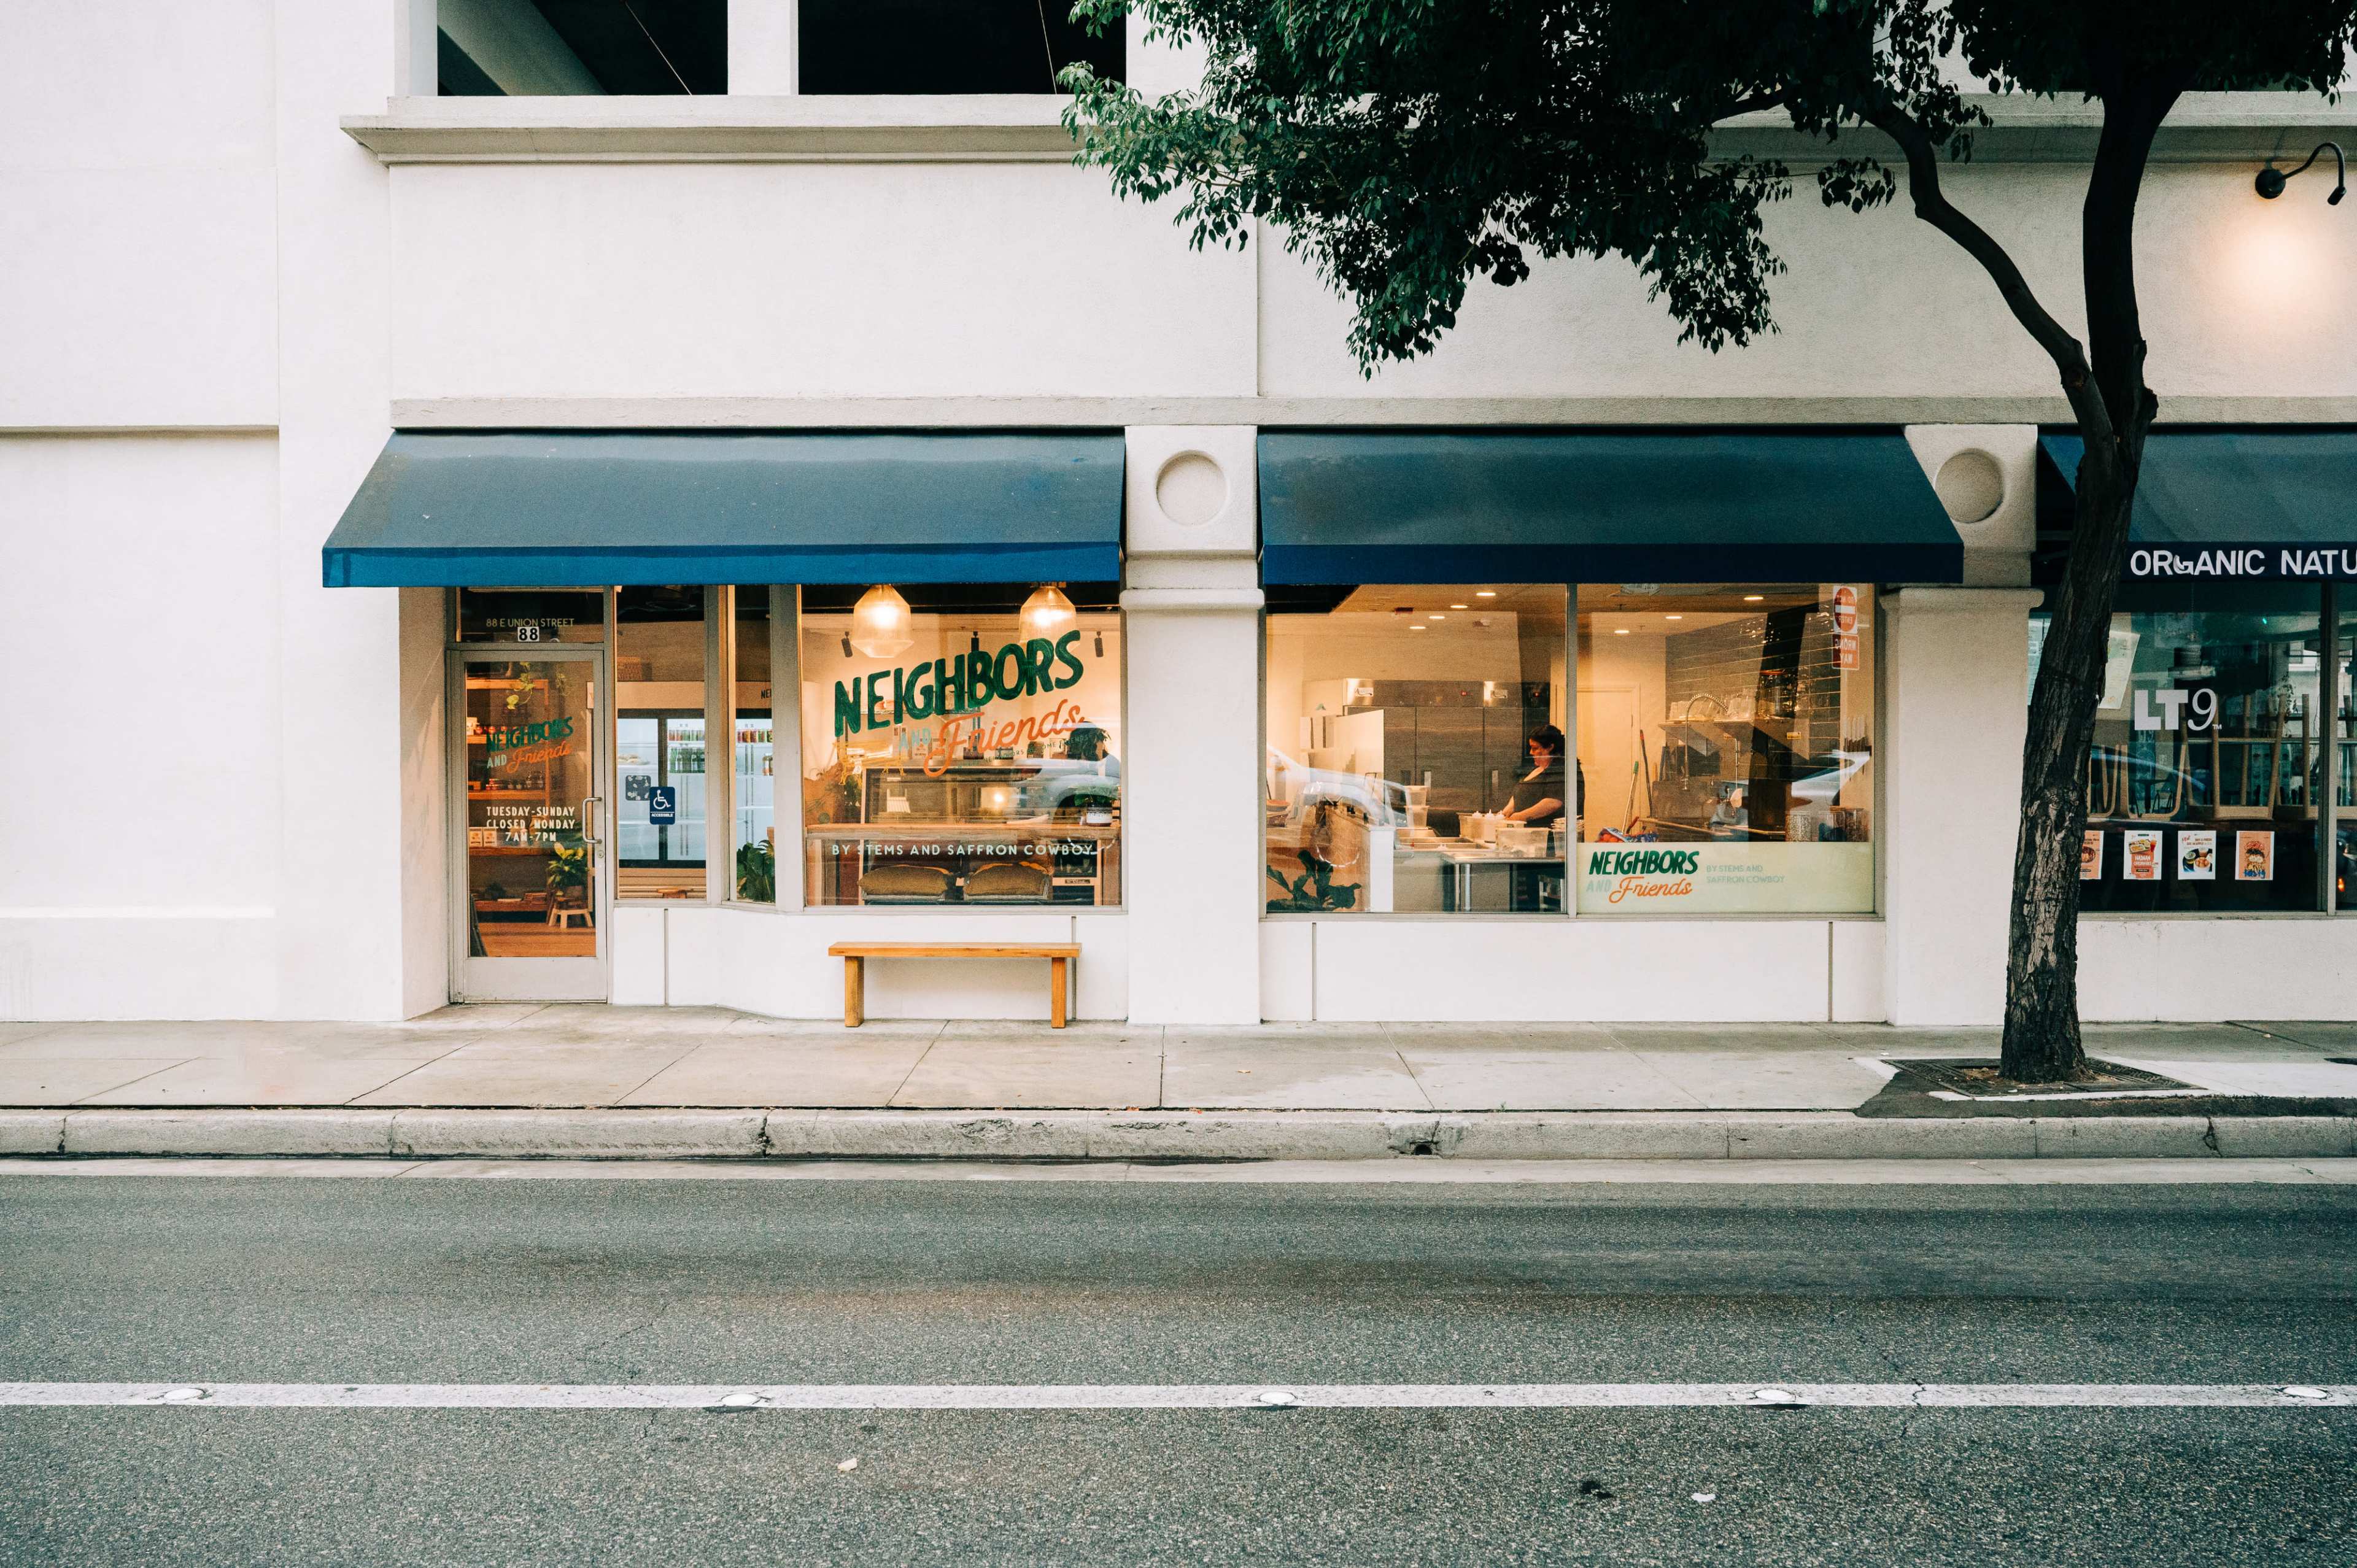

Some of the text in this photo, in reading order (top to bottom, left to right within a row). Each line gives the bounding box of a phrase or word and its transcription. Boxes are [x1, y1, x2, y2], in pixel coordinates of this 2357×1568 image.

[486, 619, 575, 627] 88 E UNION STREET
[519, 628, 538, 641] 88
[835, 630, 1084, 738] NEIGHBORS
[486, 716, 574, 752] NEIGHBORS
[899, 698, 1085, 777] AND Friends
[487, 740, 571, 774] AND Friends
[486, 806, 575, 817] TUESDAY-SUNDAY
[486, 819, 575, 829] CLOSED MONDAY
[505, 832, 556, 842] 7AM-7PM
[832, 844, 1093, 856] BY STEMS AND SAFFRON COWBOY
[1589, 850, 1700, 875] NEIGHBORS
[1586, 875, 1693, 903] AND Friends
